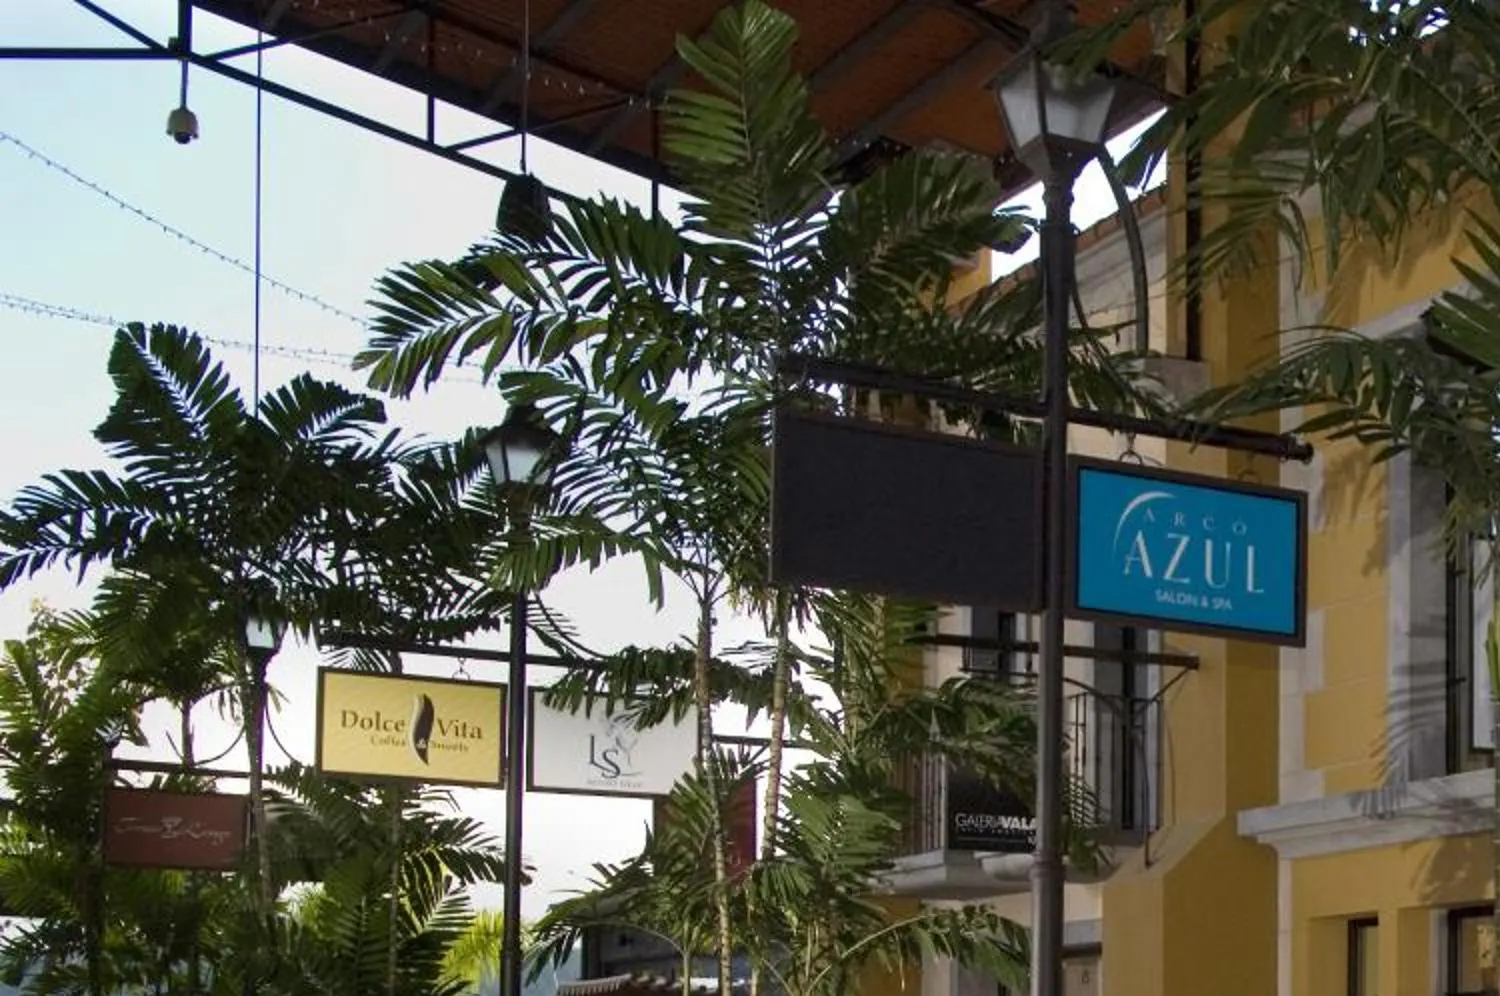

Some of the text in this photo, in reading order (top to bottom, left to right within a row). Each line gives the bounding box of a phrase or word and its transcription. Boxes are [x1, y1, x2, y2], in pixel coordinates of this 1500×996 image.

[1143, 507, 1248, 536] ARCO
[1122, 529, 1265, 594] AZUL
[1155, 588, 1233, 611] SALON & SPA
[341, 709, 482, 739] Dolce Vita
